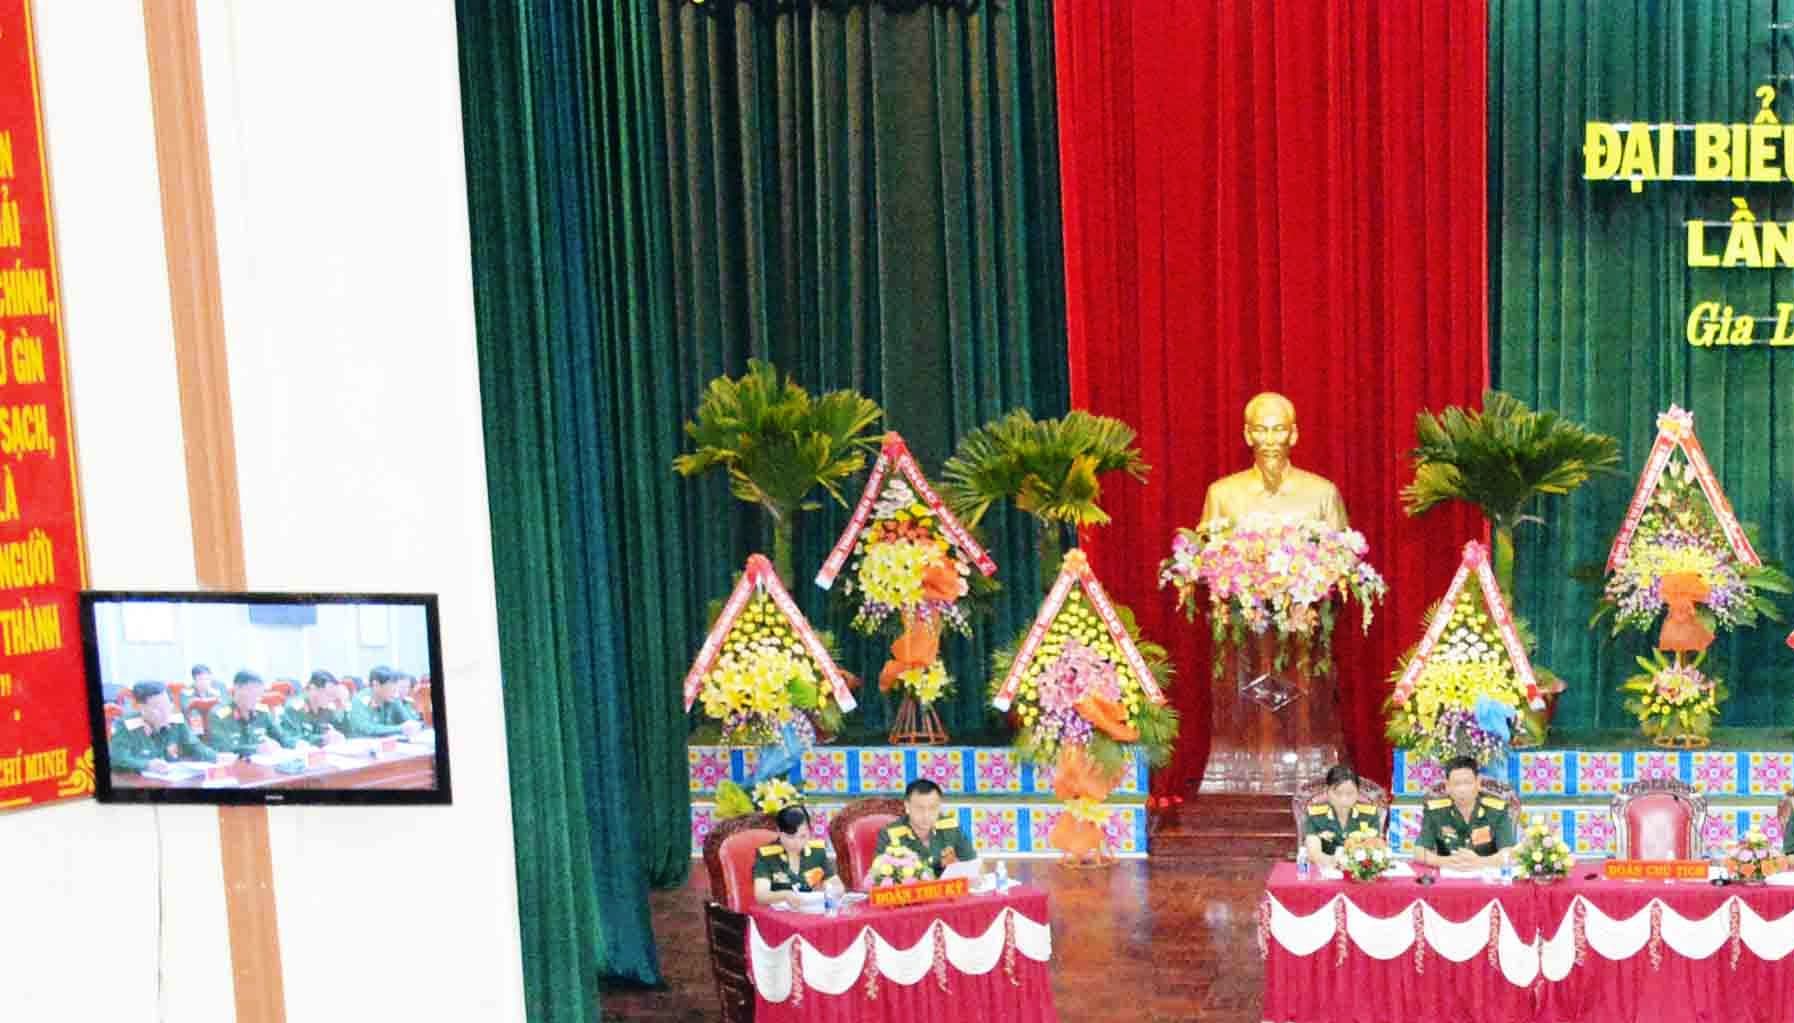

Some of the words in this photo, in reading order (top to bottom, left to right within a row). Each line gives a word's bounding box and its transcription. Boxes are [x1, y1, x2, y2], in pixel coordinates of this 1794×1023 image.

[1583, 121, 1675, 193] ĐẠI
[1687, 301, 1753, 347] Gia
[11, 327, 46, 384] GÌN
[0, 404, 56, 462] SẠCH,
[0, 597, 62, 657] THÀNH
[24, 747, 69, 784] MINH
